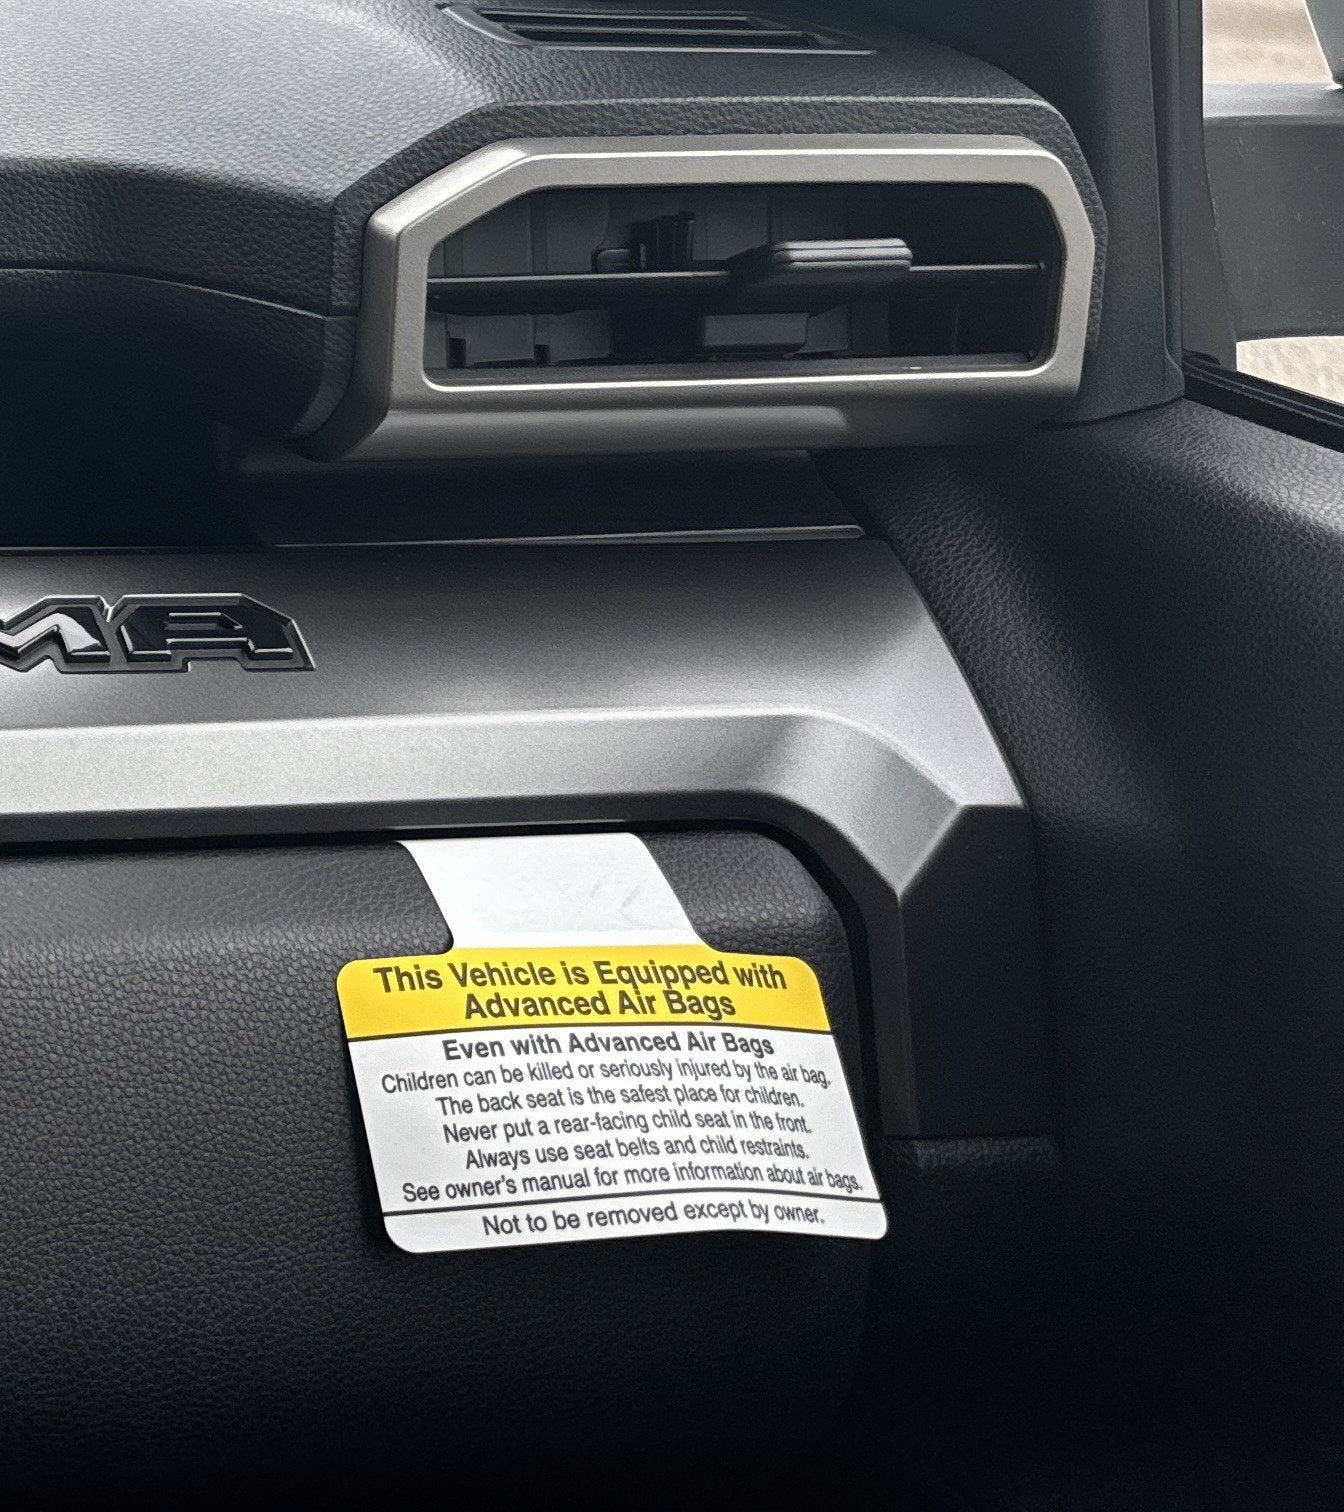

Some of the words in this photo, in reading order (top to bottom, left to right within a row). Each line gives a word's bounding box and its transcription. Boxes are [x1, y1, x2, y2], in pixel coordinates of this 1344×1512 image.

[373, 963, 443, 993] This
[447, 961, 556, 988] Vehicle
[560, 961, 590, 985] is
[593, 959, 730, 989] Equipped
[732, 962, 787, 989] with
[465, 990, 612, 1020] Advanced
[618, 989, 656, 1015] Air
[662, 989, 736, 1021] Bags
[442, 1039, 506, 1061] Even
[510, 1034, 562, 1056] with
[568, 1031, 681, 1053] Advanced
[687, 1031, 716, 1052] Air
[722, 1032, 775, 1059] Bags
[382, 1071, 459, 1094] Children
[463, 1069, 497, 1087] can
[500, 1064, 524, 1084] be
[527, 1060, 574, 1082] killed
[578, 1063, 595, 1078] or
[600, 1059, 673, 1080] seriously
[677, 1058, 731, 1081] injured
[733, 1061, 751, 1082] by
[754, 1061, 778, 1080] the
[781, 1063, 798, 1082] air
[800, 1066, 832, 1088] bag.
[435, 1096, 474, 1116] The
[477, 1091, 523, 1113] back
[526, 1089, 565, 1109] seat
[567, 1087, 584, 1106] is
[587, 1087, 616, 1105] the
[621, 1084, 672, 1104] safest
[674, 1084, 718, 1106] place
[720, 1084, 740, 1103] for
[745, 1085, 804, 1108] children.
[442, 1123, 498, 1143] Never
[503, 1118, 534, 1143] put
[538, 1119, 551, 1135] a
[554, 1111, 649, 1134] rear-facing
[652, 1109, 692, 1129] child
[694, 1111, 730, 1128] seat
[731, 1109, 748, 1129] in
[749, 1111, 774, 1130] the
[775, 1112, 812, 1134] front.
[466, 1148, 531, 1170] Always
[535, 1147, 569, 1163] use
[574, 1139, 615, 1161] seat
[615, 1135, 660, 1157] belts
[665, 1136, 697, 1155] and
[700, 1135, 738, 1154] child
[740, 1138, 809, 1159] restraints.
[402, 1182, 440, 1203] See
[446, 1175, 517, 1198] owner's
[522, 1168, 591, 1194] manual
[594, 1166, 619, 1186] for
[624, 1167, 671, 1184] more
[672, 1161, 763, 1182] information
[766, 1163, 804, 1185] about
[807, 1167, 824, 1186] air
[825, 1168, 863, 1193] bags.
[482, 1215, 523, 1235] Not
[526, 1213, 547, 1232] to
[552, 1210, 581, 1230] be
[587, 1201, 678, 1227] removed
[683, 1199, 747, 1221] except
[748, 1199, 769, 1224] by
[774, 1204, 825, 1224] owner.
